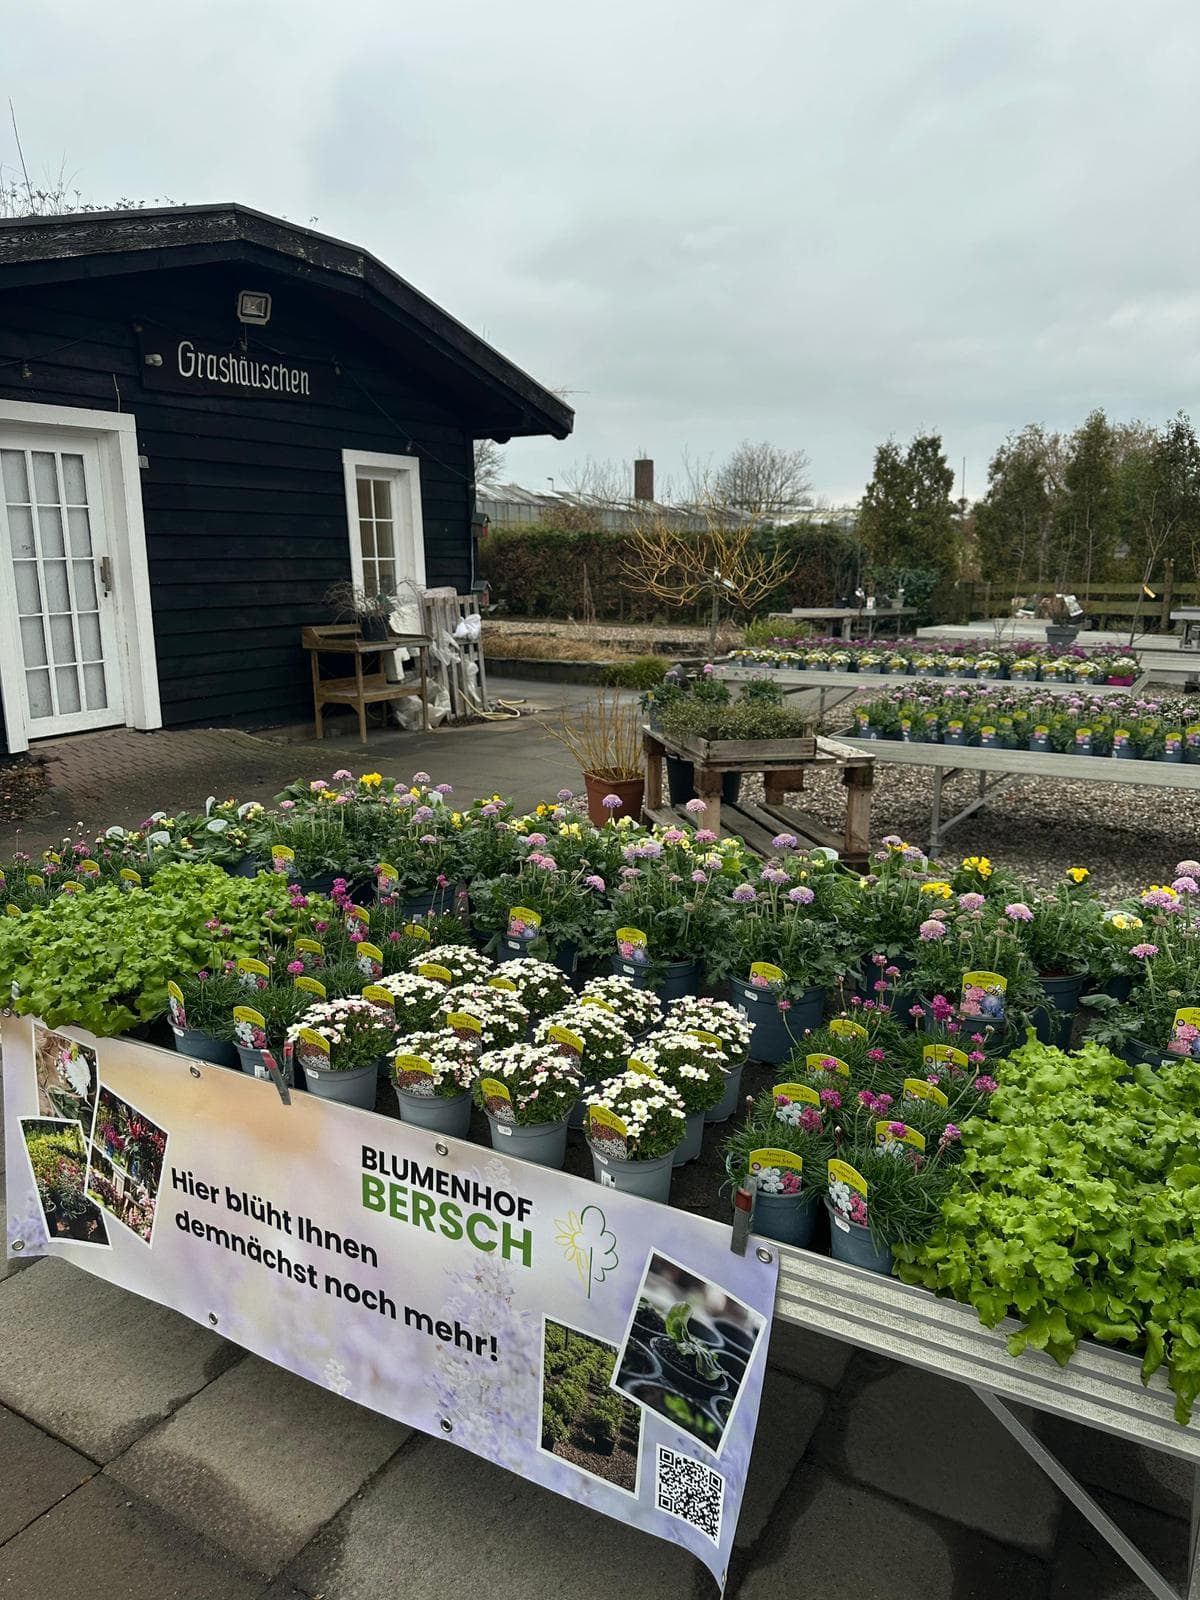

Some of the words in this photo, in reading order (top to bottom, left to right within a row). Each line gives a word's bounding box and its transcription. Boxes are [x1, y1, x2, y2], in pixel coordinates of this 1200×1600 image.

[177, 340, 310, 395] Grashäuschen
[171, 1167, 220, 1205] Hier
[225, 1185, 292, 1236] blüht
[297, 1216, 379, 1269] Ihnen
[361, 1145, 533, 1223] BLUMENHOF
[361, 1172, 533, 1269] BERSCH
[174, 1209, 319, 1291] demnächst
[324, 1272, 397, 1320] noch
[404, 1304, 499, 1363] mehr!
